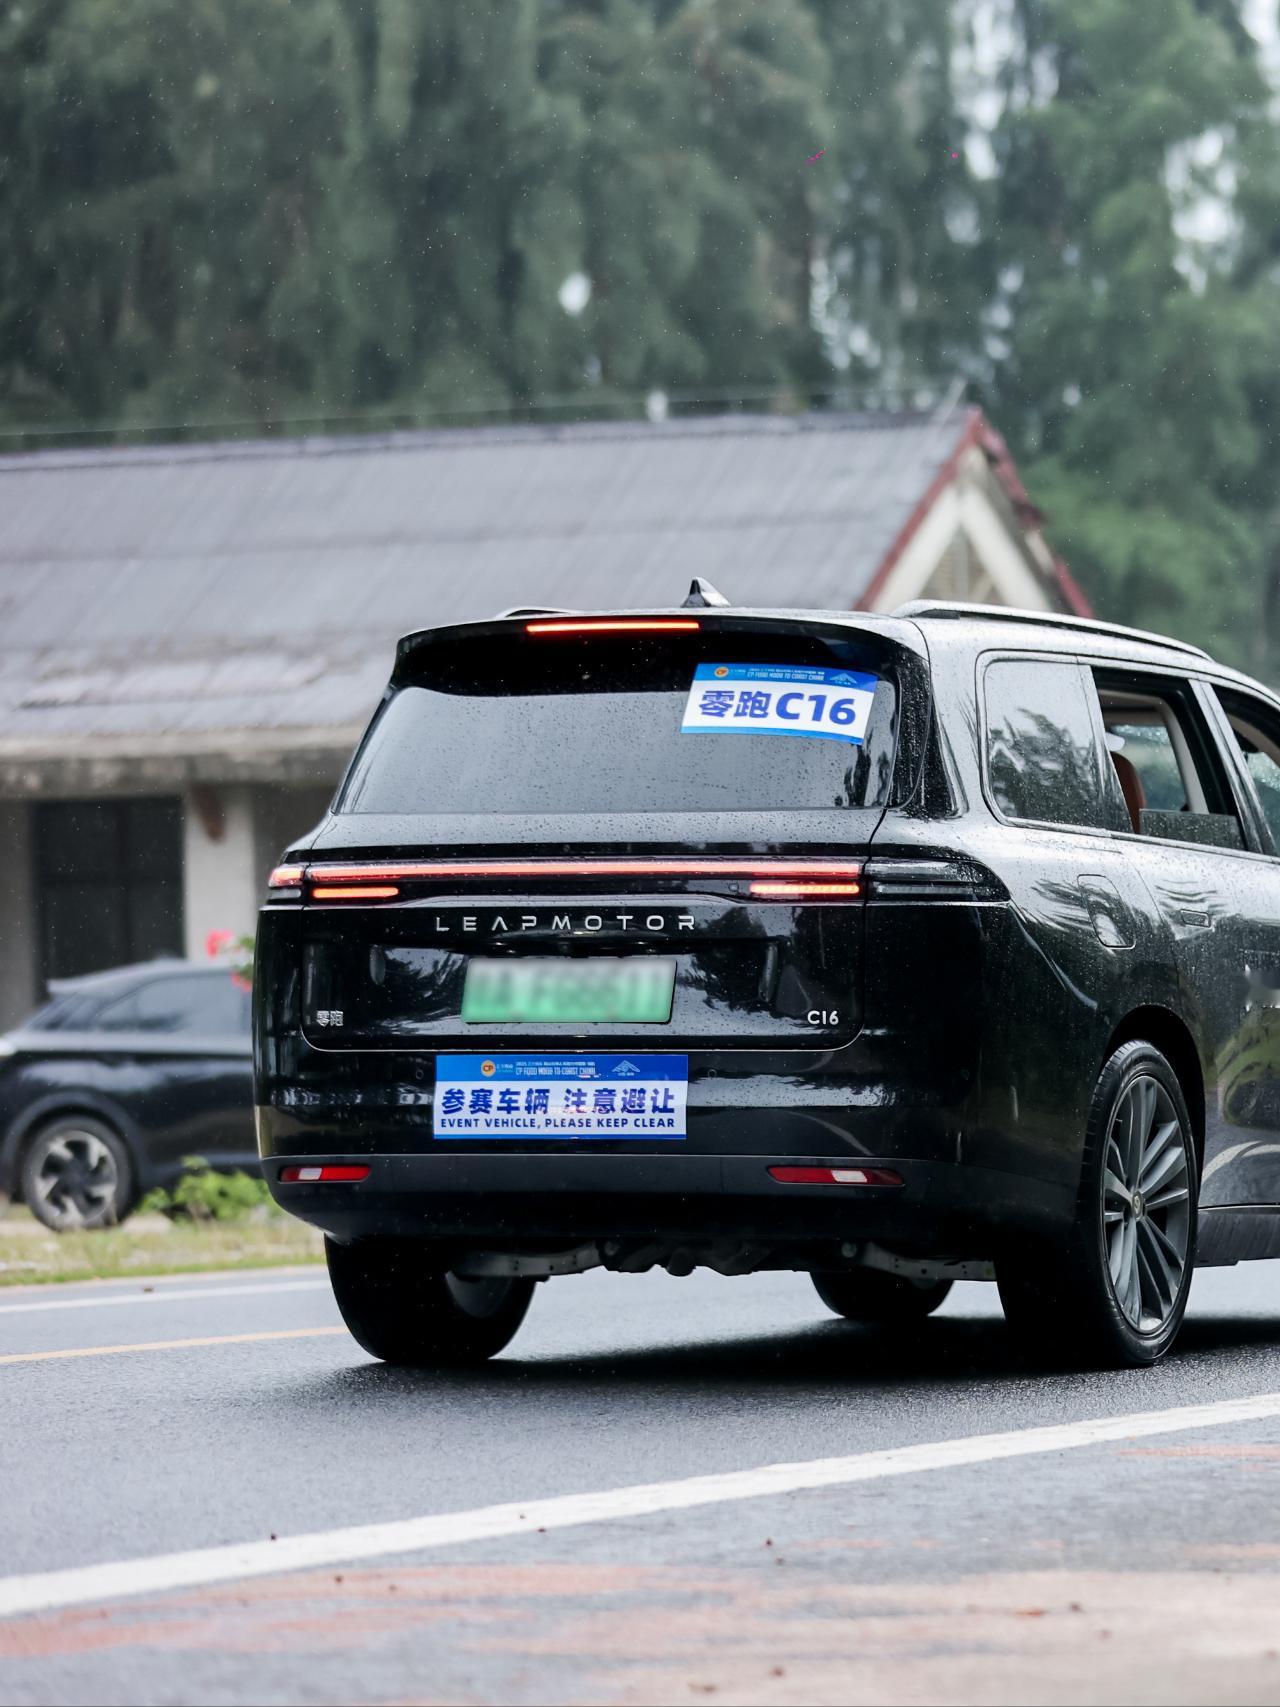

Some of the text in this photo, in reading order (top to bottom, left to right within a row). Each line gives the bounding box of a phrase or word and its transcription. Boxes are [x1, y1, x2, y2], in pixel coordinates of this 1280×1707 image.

[698, 690, 856, 725] 零跑C16
[436, 915, 695, 931] LEAPMOTOR
[316, 1010, 344, 1026] 零跑
[807, 1010, 839, 1025] C16
[441, 1088, 675, 1115] 参赛车辆 注意避让
[441, 1119, 675, 1130] EVENT VEHICLE, PLEASE KEEP CLEAR
